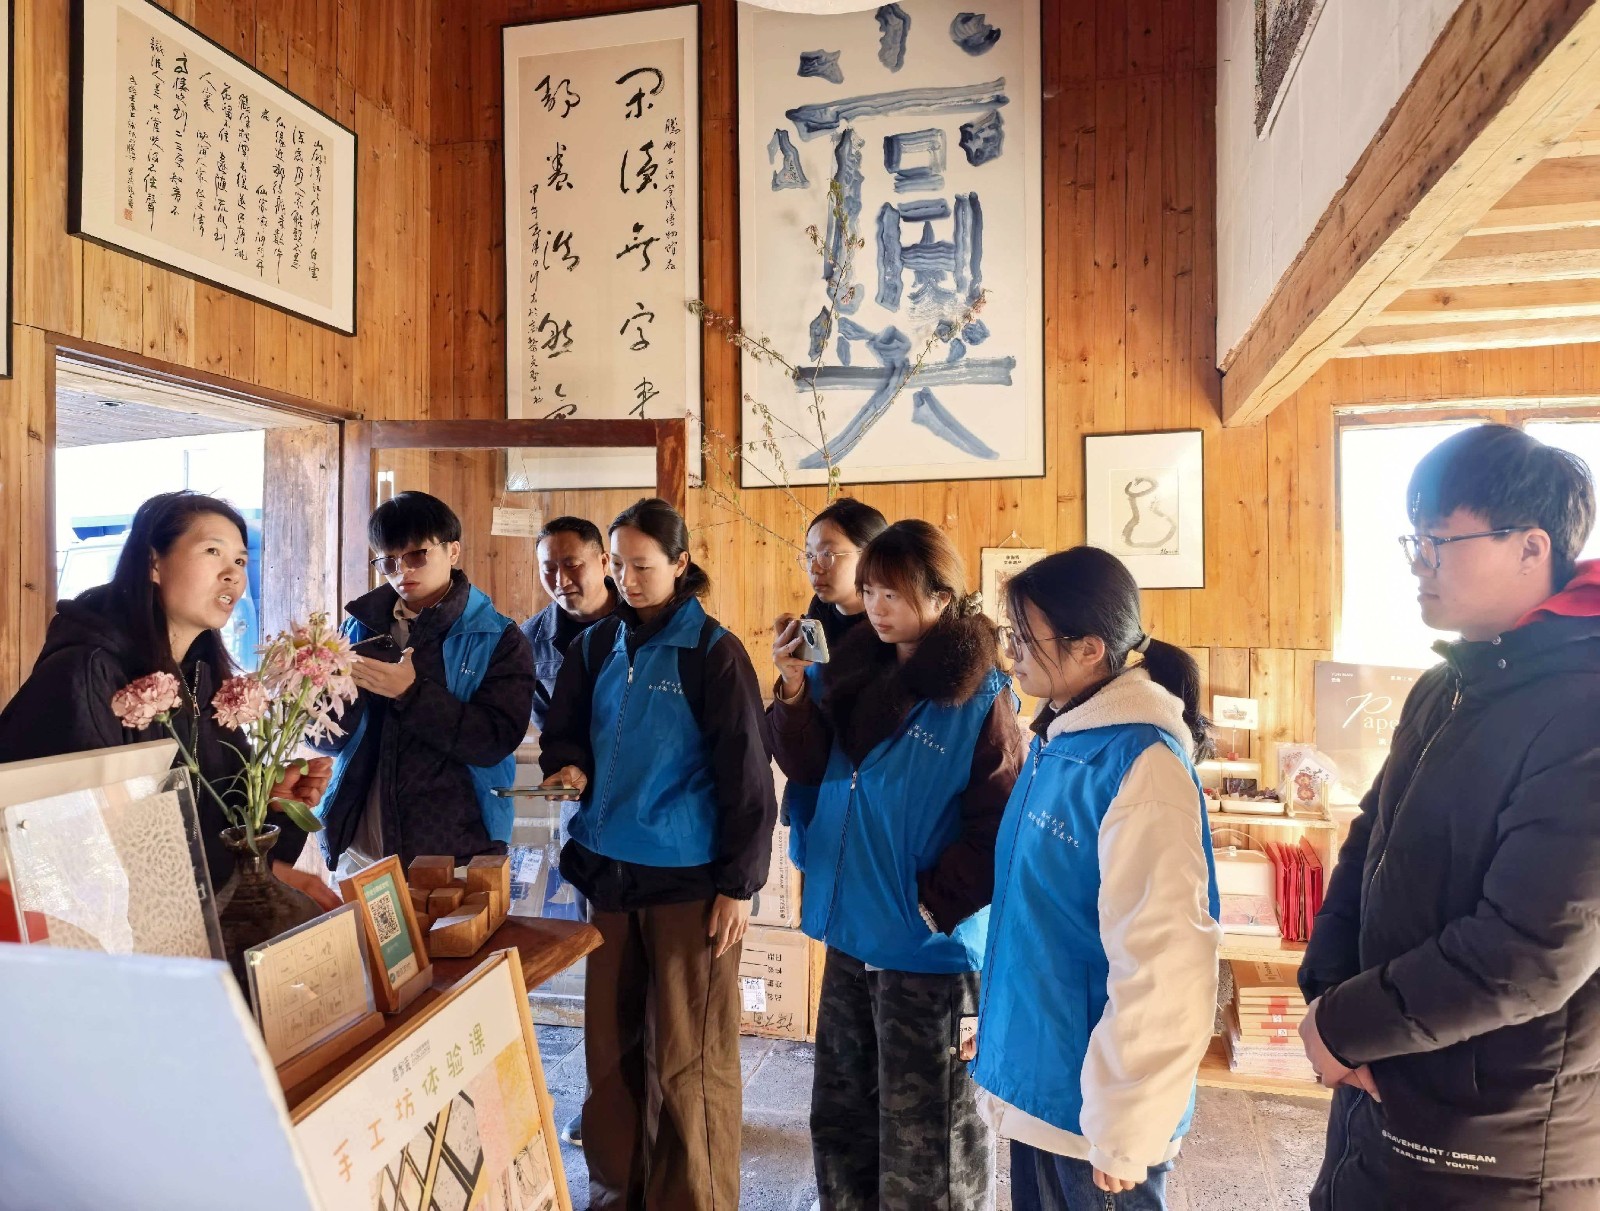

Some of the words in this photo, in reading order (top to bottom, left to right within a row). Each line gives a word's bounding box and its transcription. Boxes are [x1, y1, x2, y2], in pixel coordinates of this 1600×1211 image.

[333, 1022, 486, 1182] 手工坊体验课
[1451, 1151, 1497, 1164] DREAM
[1445, 1160, 1479, 1171] YOUTH
